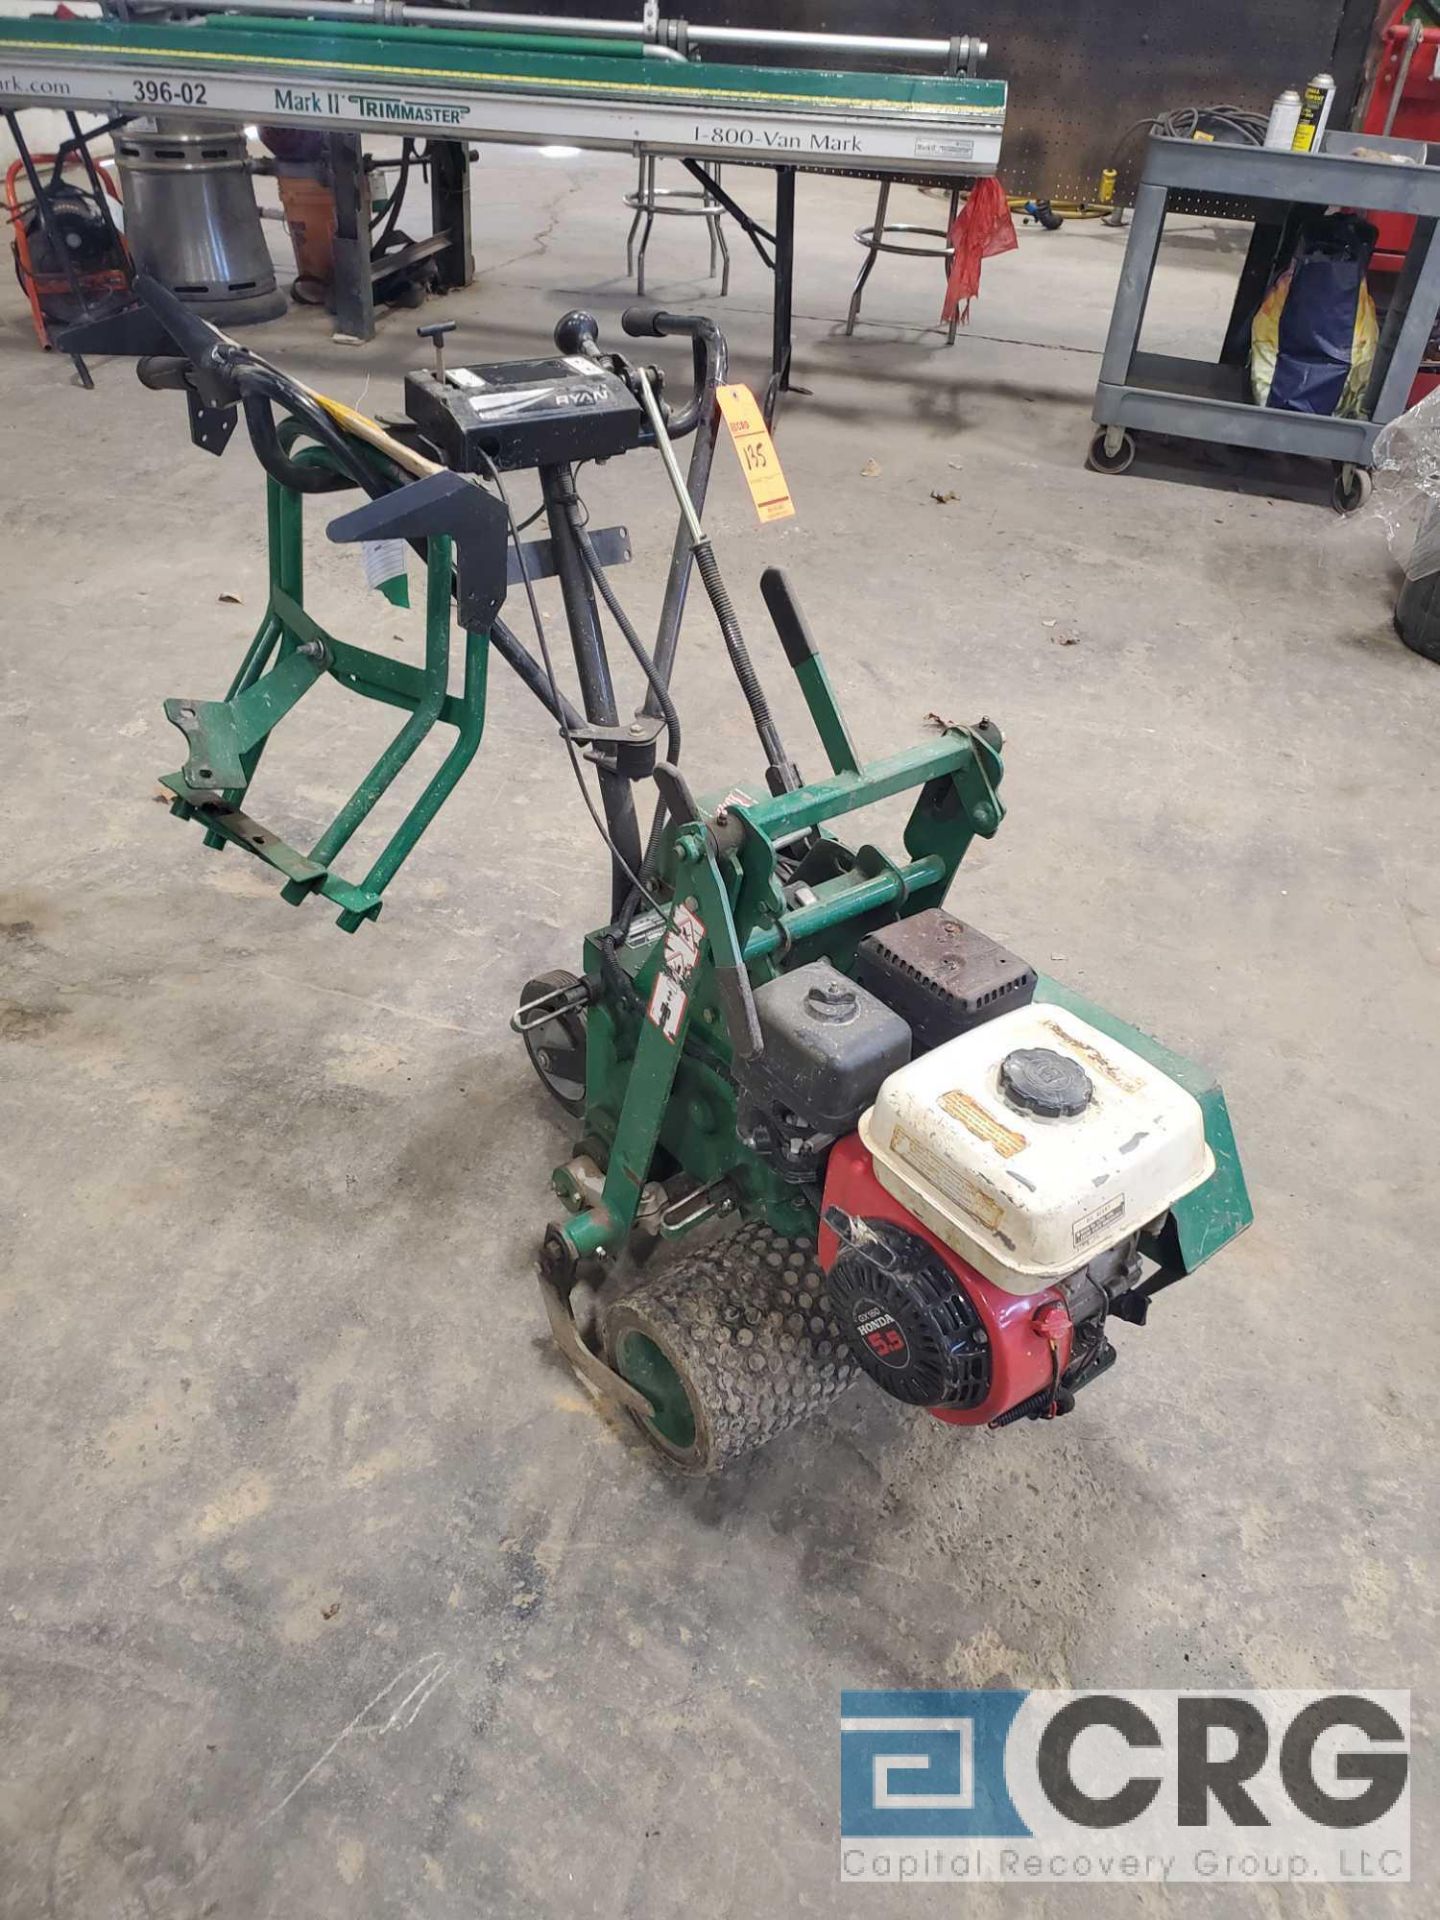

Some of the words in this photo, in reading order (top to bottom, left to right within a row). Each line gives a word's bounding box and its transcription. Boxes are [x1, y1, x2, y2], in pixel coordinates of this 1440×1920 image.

[133, 80, 207, 104] 396-02
[274, 89, 321, 112] Mark
[328, 93, 339, 114] II
[348, 95, 470, 124] TRIMMASTER
[694, 126, 800, 148] 1-800-Van
[810, 134, 862, 152] Mark
[556, 389, 608, 405] RYAN
[743, 442, 766, 470] 135
[857, 1313, 896, 1335] HONDA
[867, 1329, 905, 1357] 5.5
